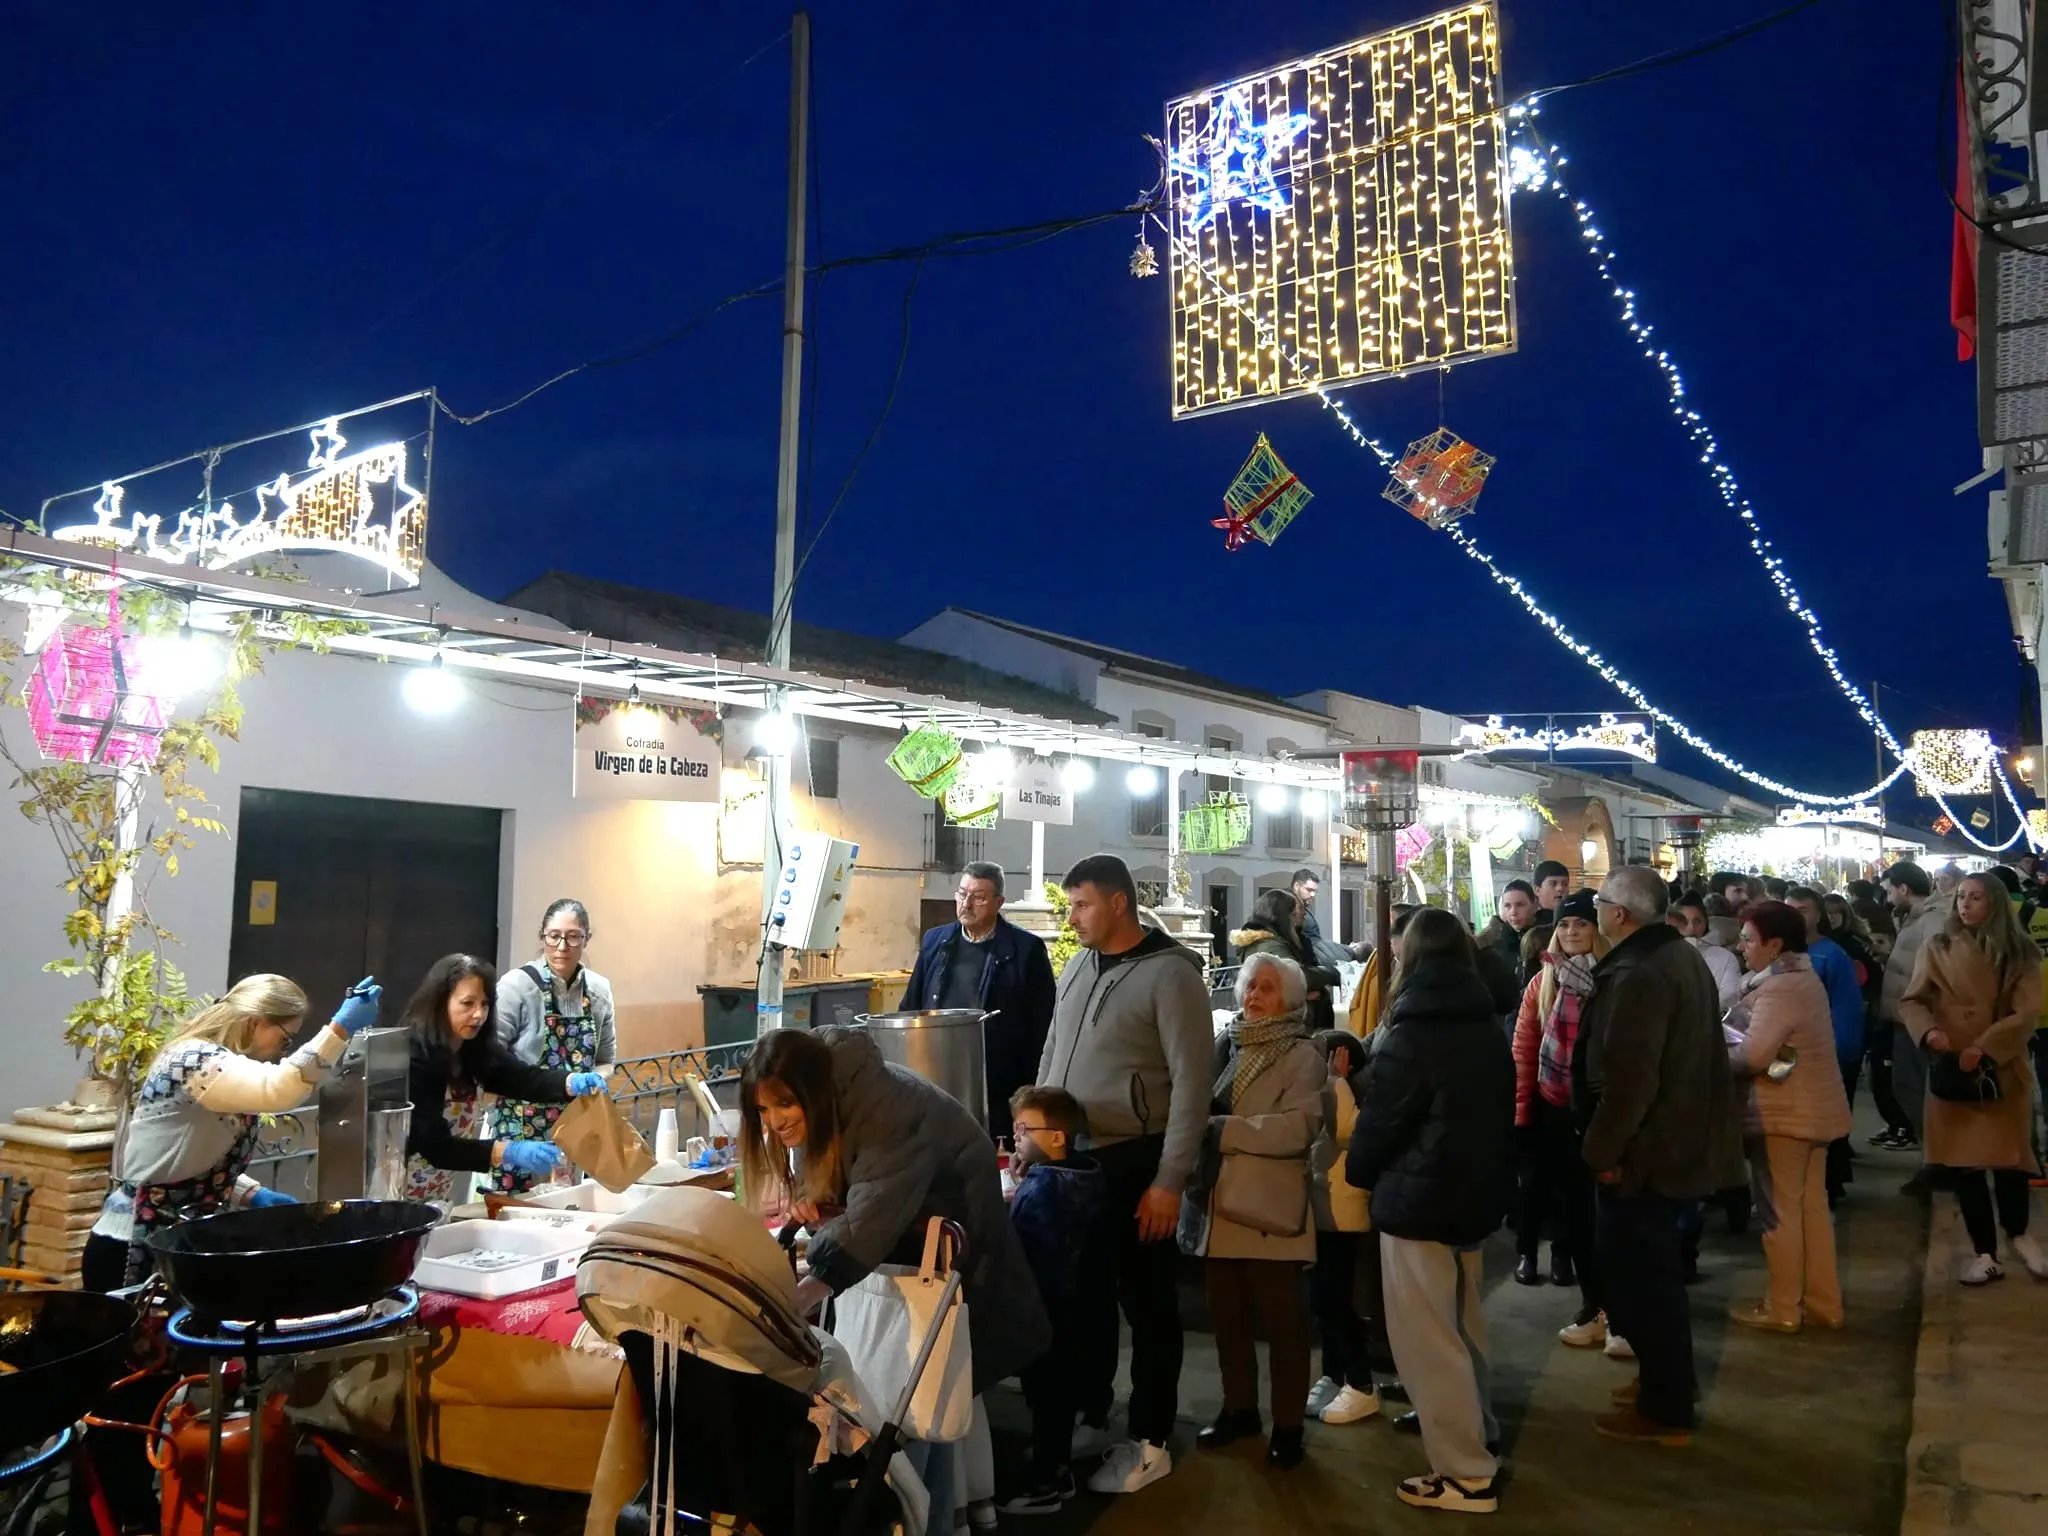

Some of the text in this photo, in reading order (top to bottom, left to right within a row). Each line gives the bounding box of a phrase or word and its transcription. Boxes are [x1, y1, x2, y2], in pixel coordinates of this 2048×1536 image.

[626, 737, 665, 750] Cofradía
[595, 751, 708, 778] Virgen de la Cabeza
[1019, 789, 1061, 807] Las Tinajas
